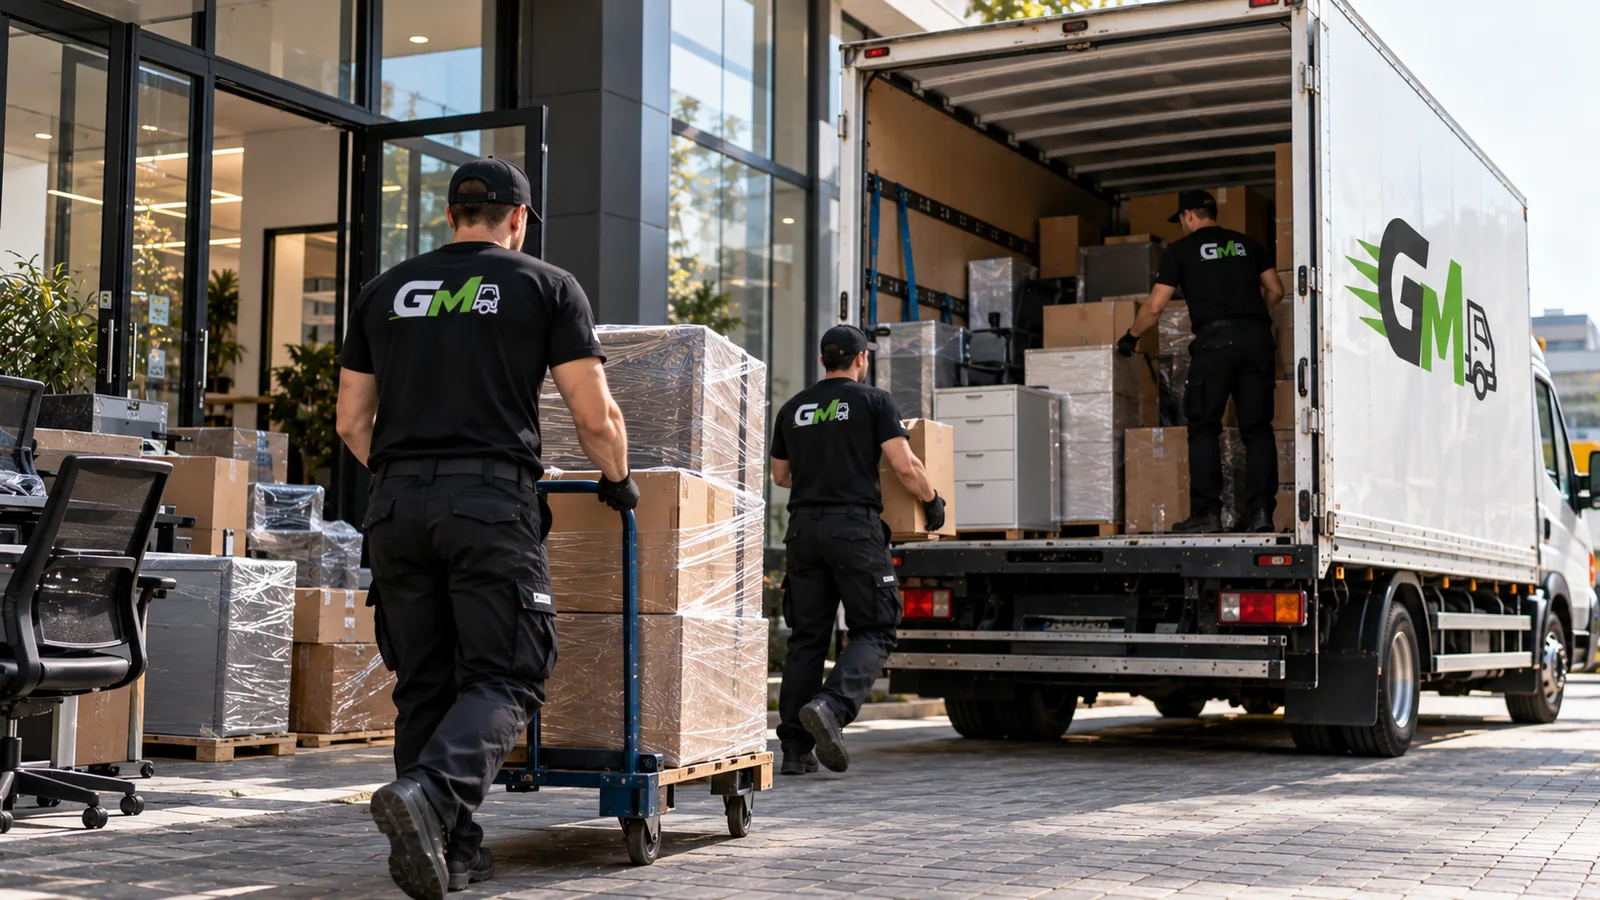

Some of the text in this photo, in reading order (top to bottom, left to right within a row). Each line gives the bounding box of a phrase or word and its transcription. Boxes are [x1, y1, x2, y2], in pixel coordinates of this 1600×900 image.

[1200, 240, 1236, 260] GM
[393, 276, 484, 317] GM
[1378, 218, 1465, 387] GM
[794, 399, 840, 427] GM
